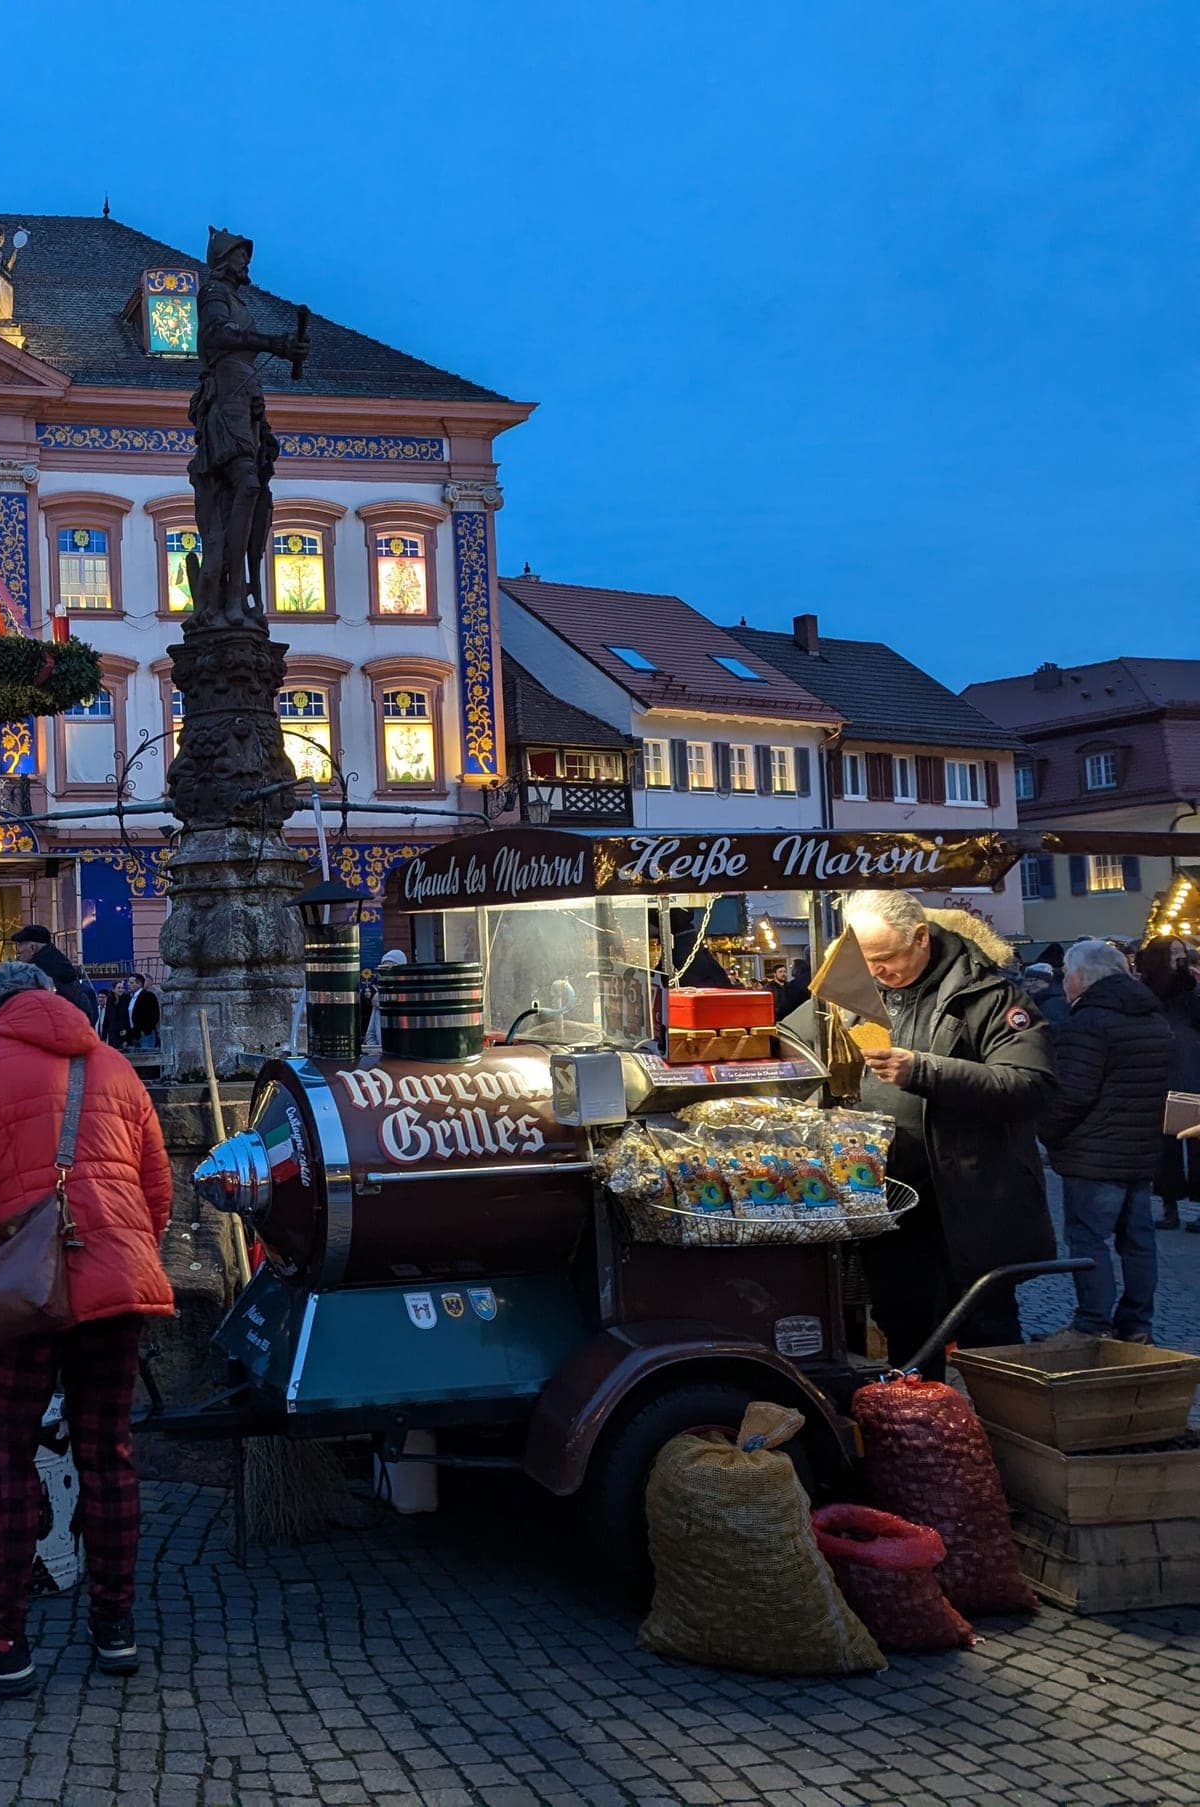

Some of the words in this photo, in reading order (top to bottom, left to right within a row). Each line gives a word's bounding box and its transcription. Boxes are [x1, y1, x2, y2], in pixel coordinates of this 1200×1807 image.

[404, 855, 460, 904] Chauds
[463, 854, 487, 895] les
[493, 845, 586, 898] Marrons
[618, 836, 748, 886] Heiße
[772, 834, 945, 880] Maroni
[336, 1067, 552, 1109] Marron
[286, 1106, 305, 1152] Castagne
[380, 1104, 546, 1164] Grillés
